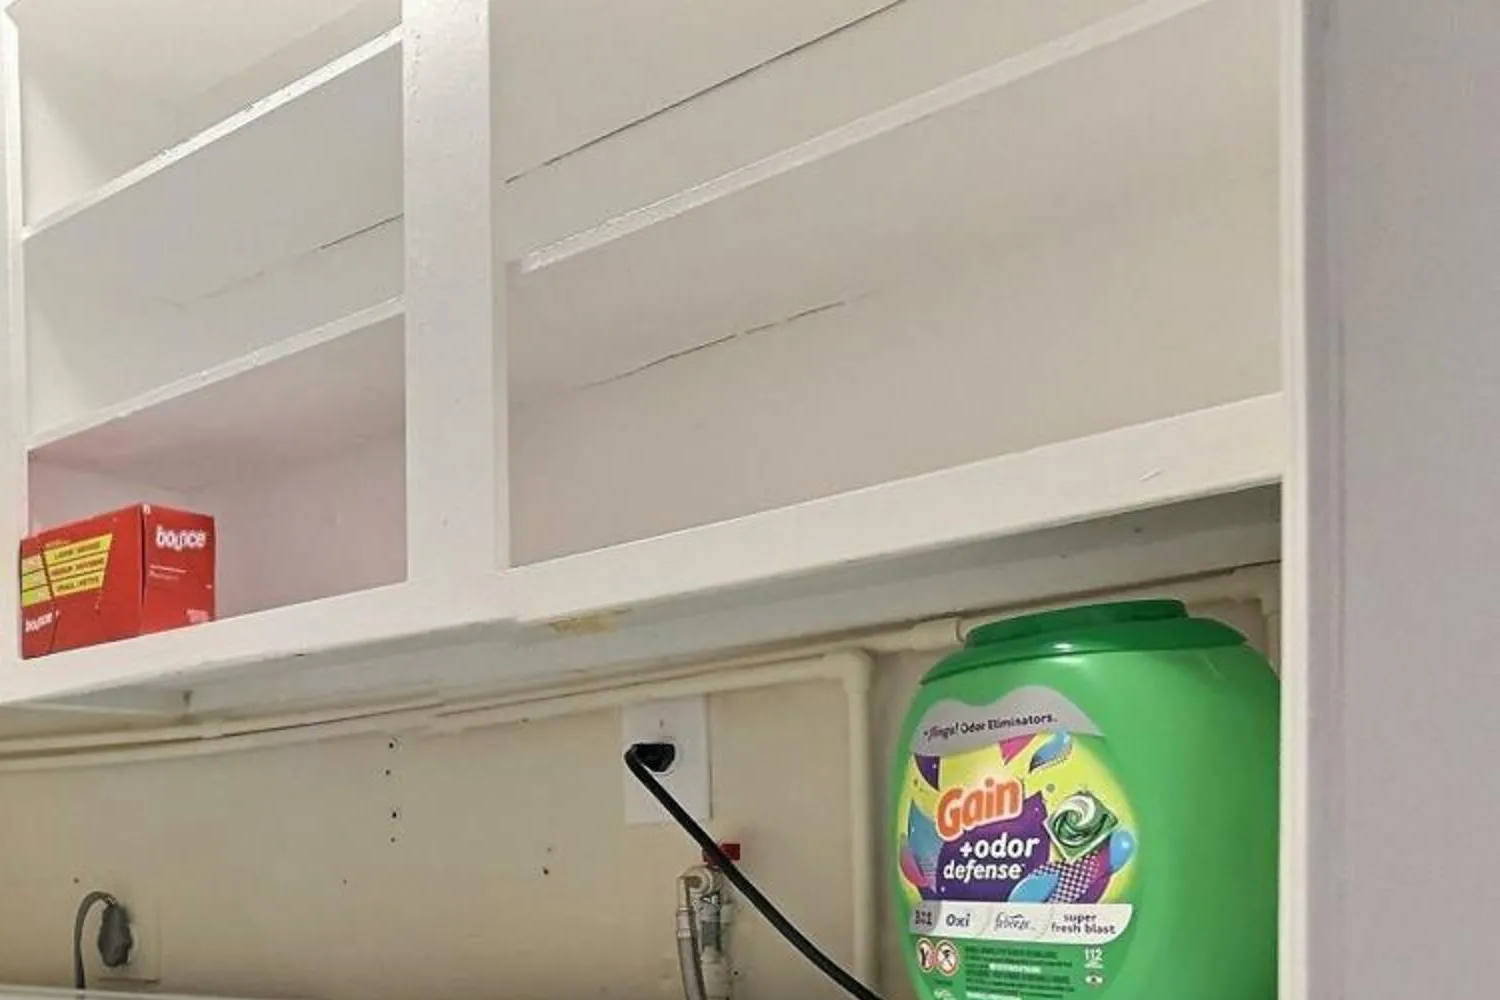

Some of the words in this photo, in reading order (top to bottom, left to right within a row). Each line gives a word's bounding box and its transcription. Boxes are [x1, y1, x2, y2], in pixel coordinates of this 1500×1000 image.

[156, 524, 206, 552] bounce
[936, 777, 1024, 841] Gain
[943, 859, 1023, 883] defense
[945, 912, 971, 927] Oxi
[1051, 922, 1082, 934] fresh
[1084, 922, 1116, 935] blast
[1063, 913, 1097, 925] super
